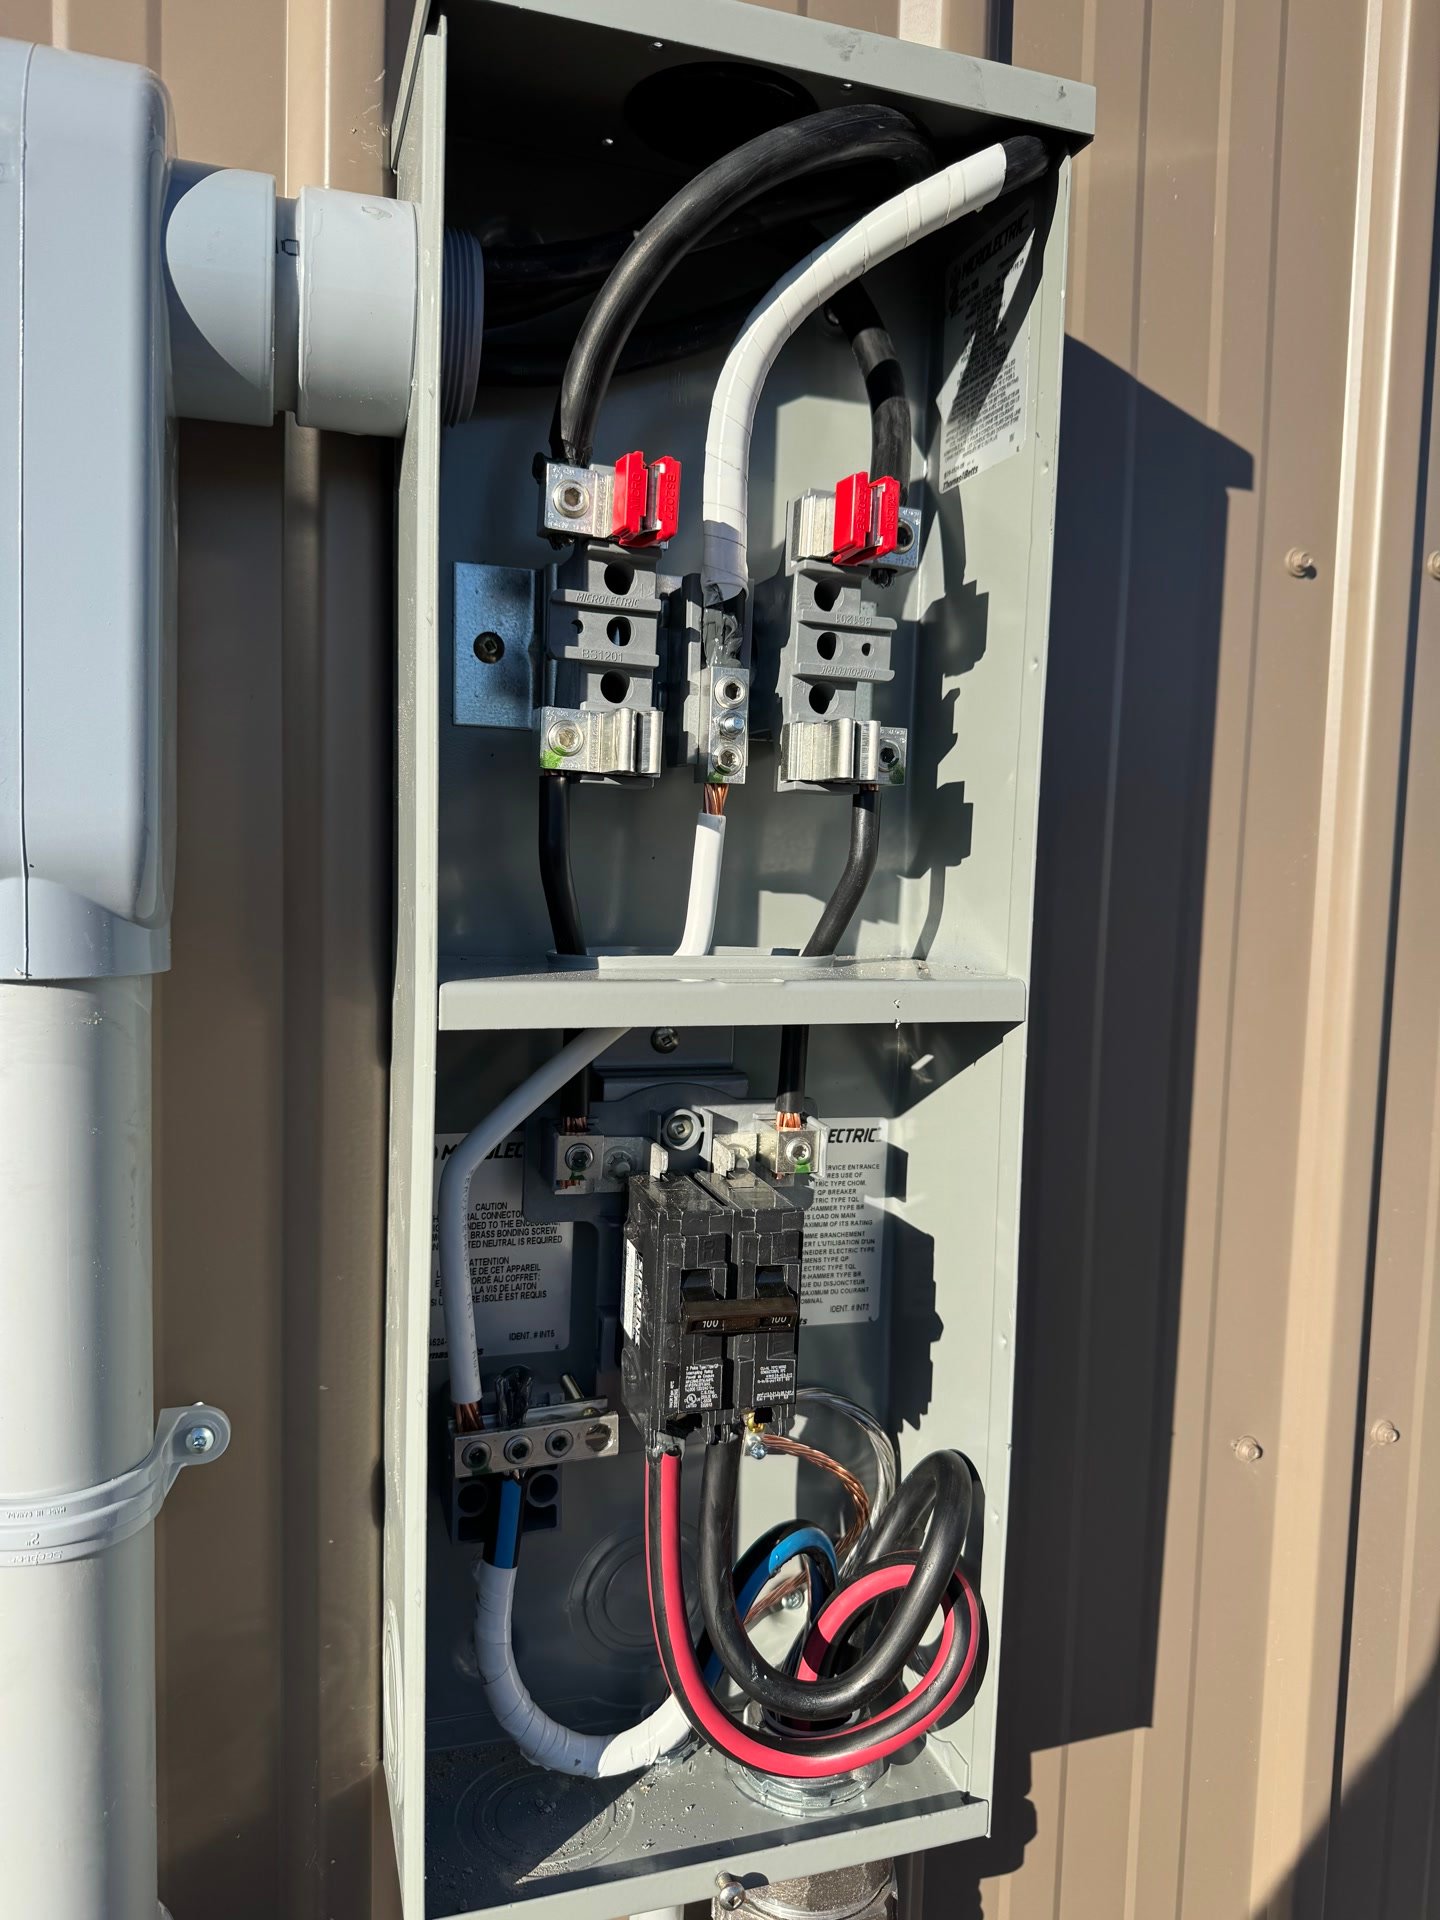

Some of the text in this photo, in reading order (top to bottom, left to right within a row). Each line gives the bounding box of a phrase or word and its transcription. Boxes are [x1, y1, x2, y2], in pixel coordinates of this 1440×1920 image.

[631, 472, 640, 511] MICRO
[576, 593, 640, 608] MICROLECTRIC
[834, 614, 872, 628] BS1201
[582, 649, 624, 662] BS1201
[475, 1202, 508, 1210] CAUTION
[470, 1227, 557, 1239] BRASS BONDING SCREW
[483, 1239, 516, 1247] NEUTRAL
[526, 1236, 562, 1244] REQUIRED
[469, 1257, 509, 1266] ATTENTION
[506, 1264, 541, 1273] APPAREIL
[475, 1282, 537, 1294] LA VIS DE LAITON
[505, 1292, 519, 1300] EST
[520, 1290, 547, 1299] REQUIS
[702, 1320, 719, 1328] 100
